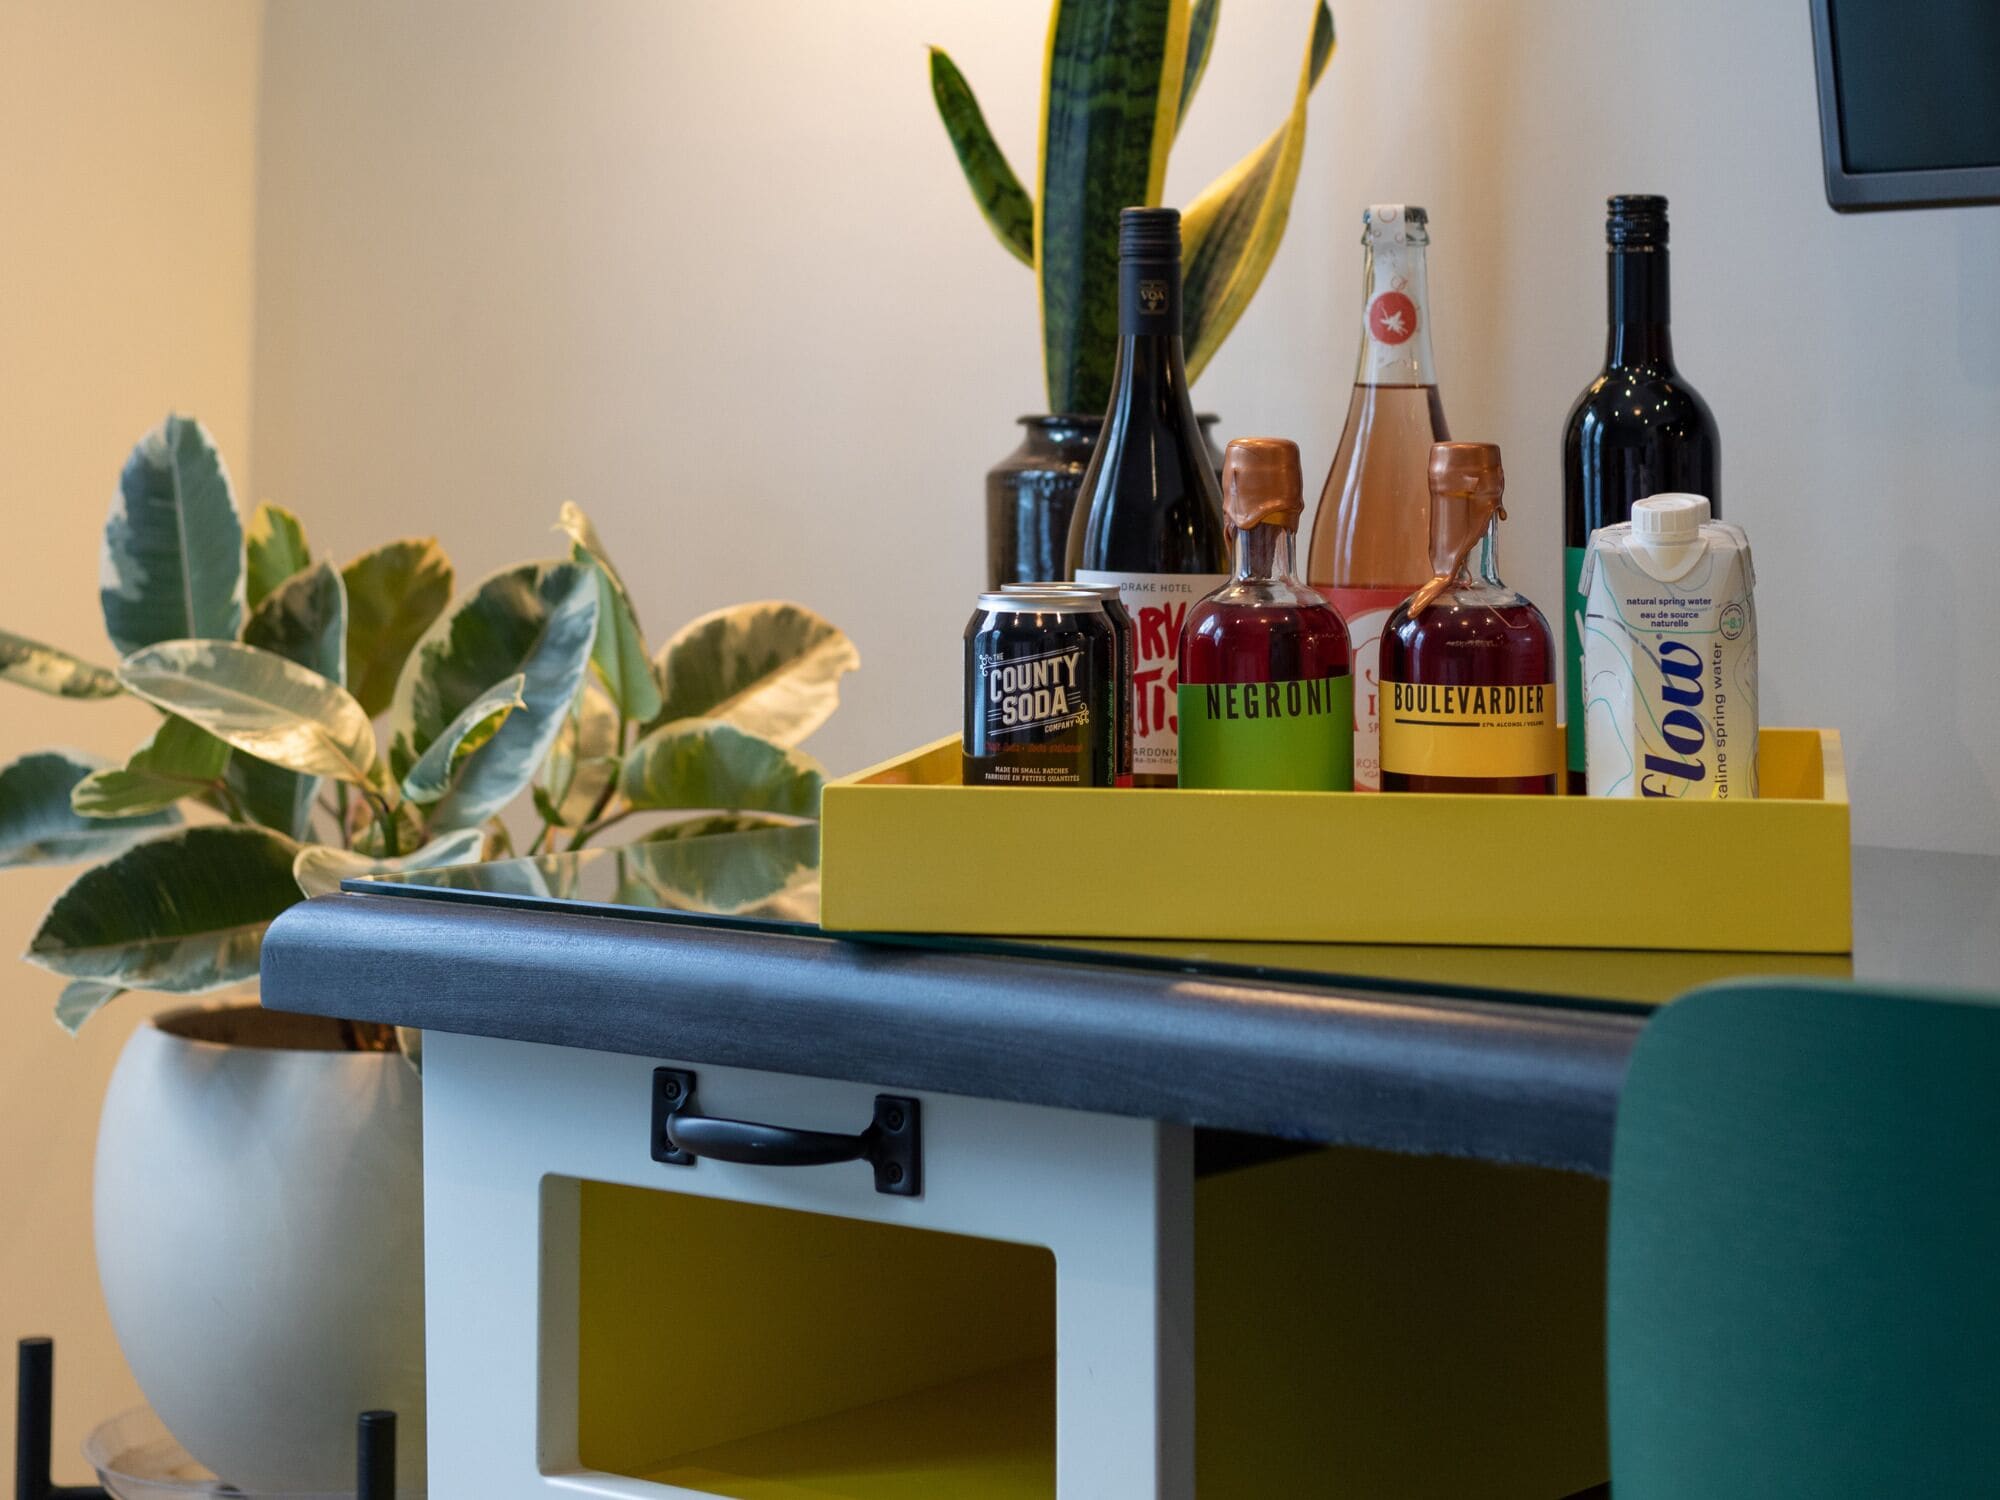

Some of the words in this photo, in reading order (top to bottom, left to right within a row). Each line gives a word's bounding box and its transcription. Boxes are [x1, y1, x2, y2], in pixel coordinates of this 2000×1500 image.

[1121, 582, 1157, 593] DRAKE
[1160, 583, 1193, 593] HOTEL
[1626, 597, 1657, 605] natural
[1658, 597, 1686, 607] spring
[1657, 610, 1669, 619] de
[990, 652, 1080, 703] COUNTY
[1712, 642, 1724, 689] water
[1002, 686, 1069, 726] SODA
[1206, 678, 1332, 720] NEGRONI
[1395, 683, 1544, 715] BOULEVARDIER
[1044, 719, 1075, 733] COMPANY
[1640, 640, 1706, 799] flow
[1712, 694, 1727, 748] spring
[995, 766, 1011, 774] MADE
